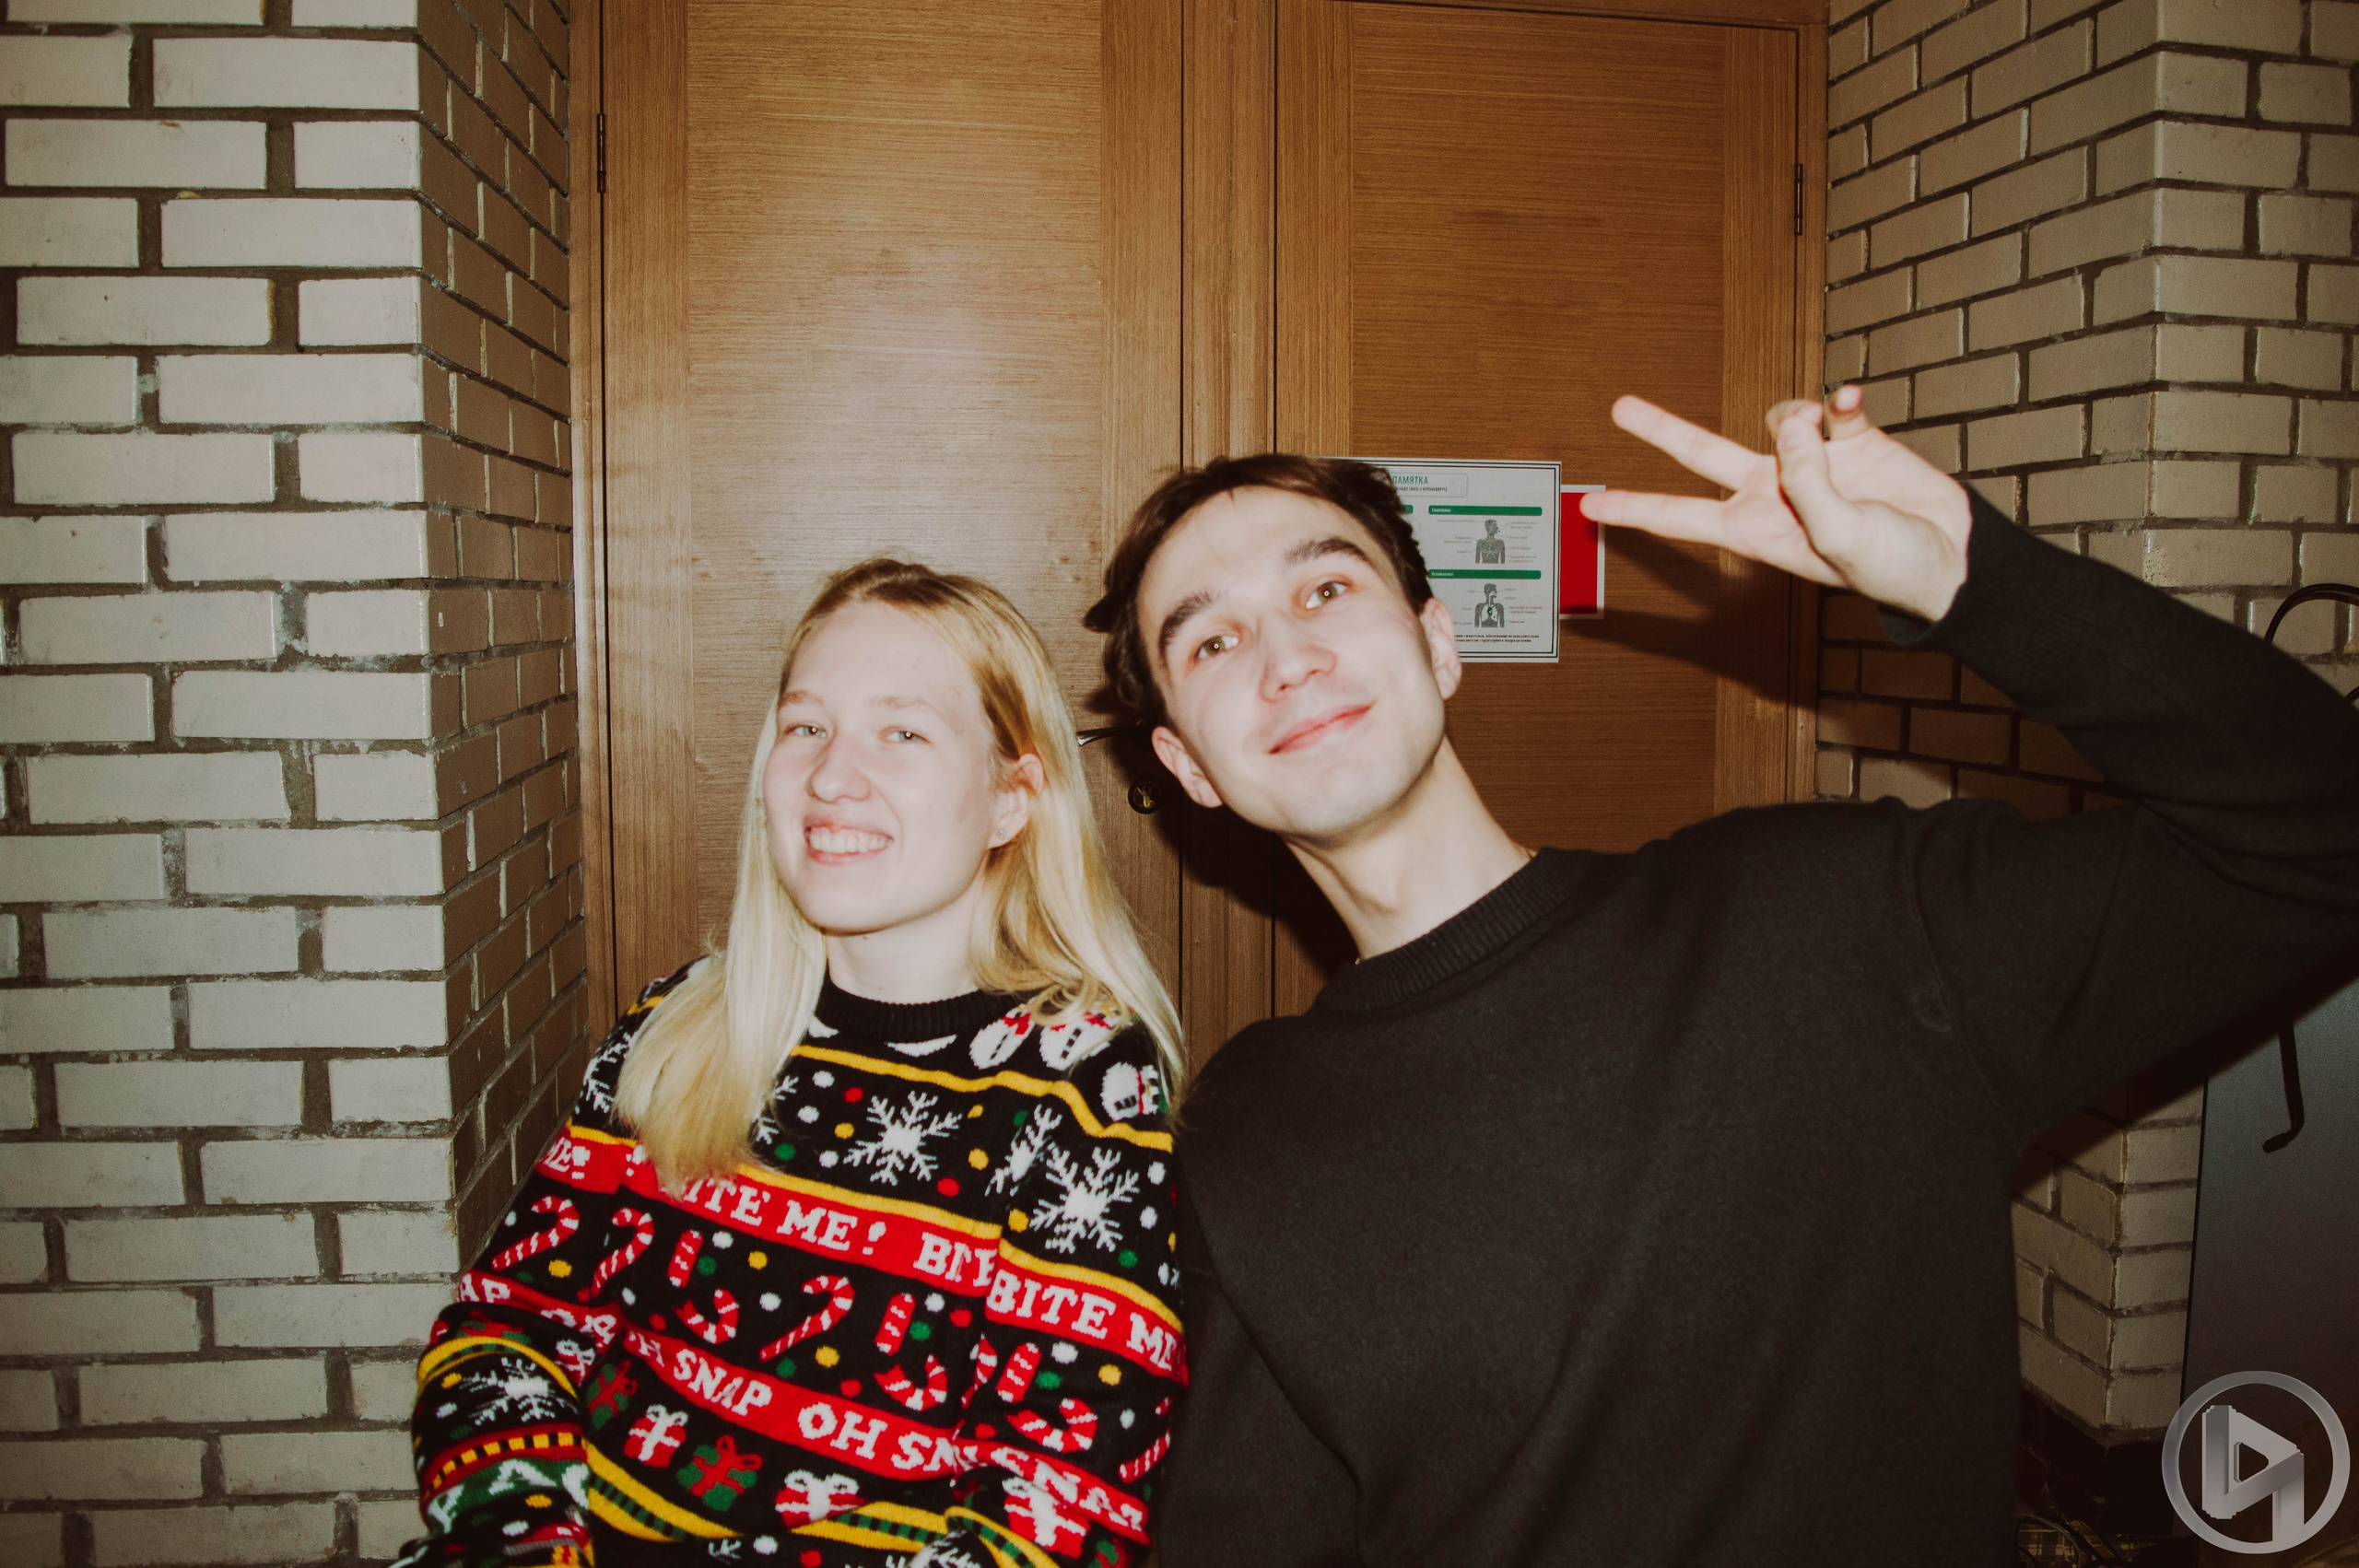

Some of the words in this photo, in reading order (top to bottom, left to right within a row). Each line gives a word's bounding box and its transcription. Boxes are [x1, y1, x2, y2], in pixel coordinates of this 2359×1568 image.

[1392, 475, 1428, 485] ПАМЯТКА
[776, 1199, 886, 1256] ME!
[986, 1269, 1116, 1340] BITE
[798, 1402, 887, 1460] OH
